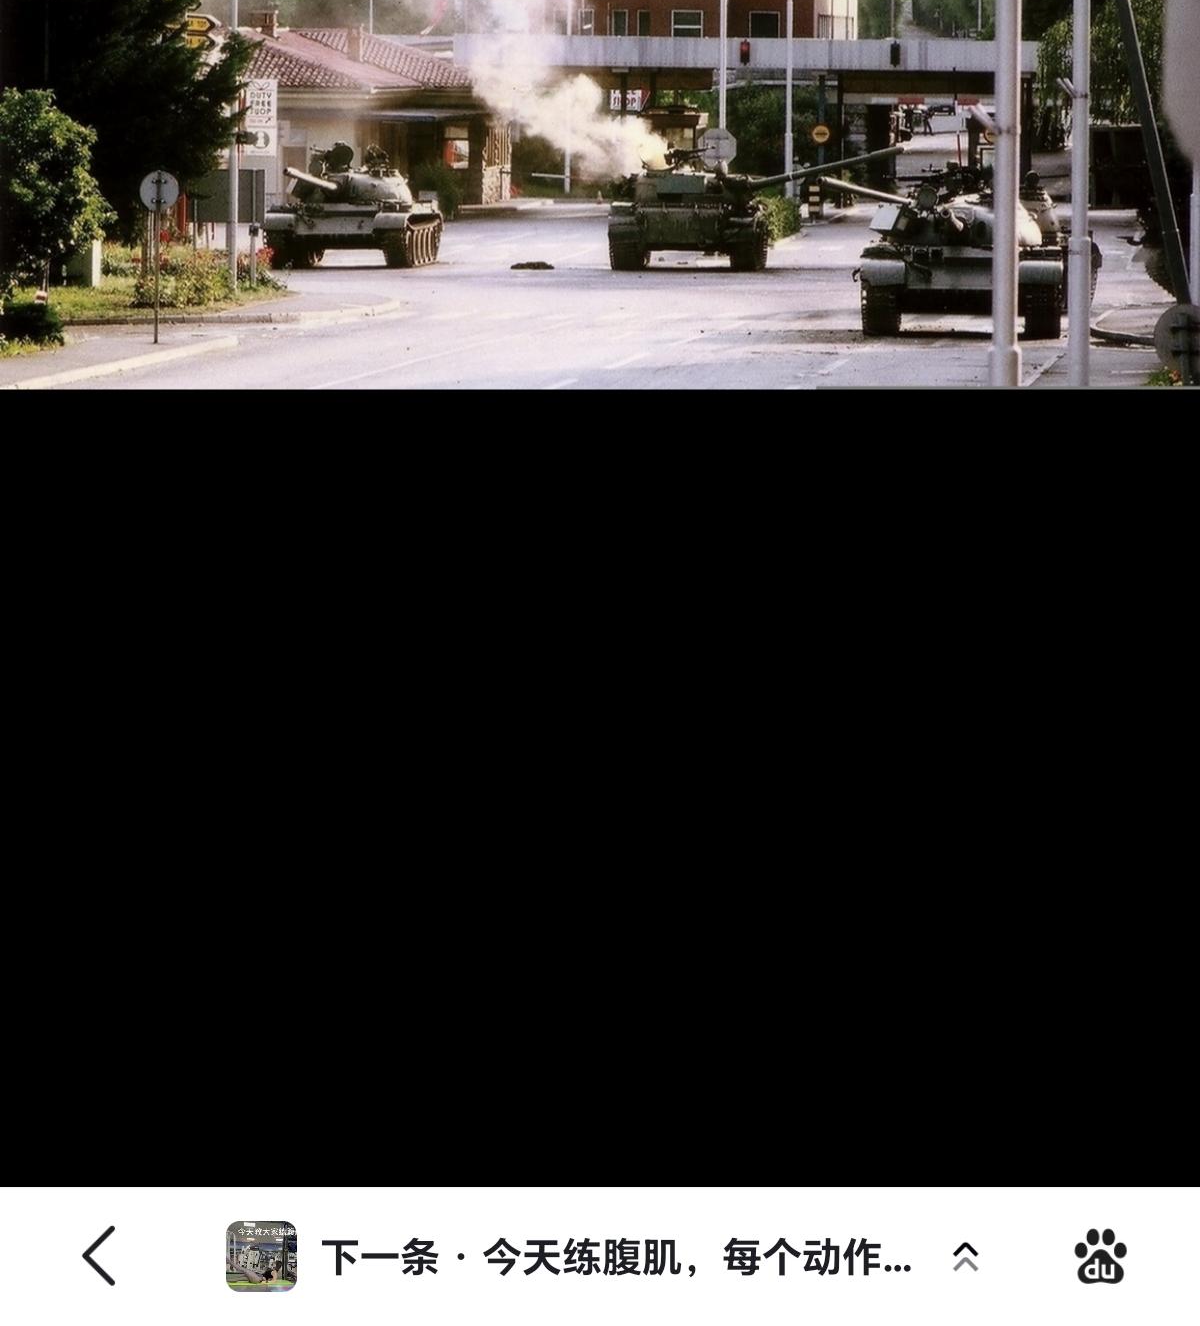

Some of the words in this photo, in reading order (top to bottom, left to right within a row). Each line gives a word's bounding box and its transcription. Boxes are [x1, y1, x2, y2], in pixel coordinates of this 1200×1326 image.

[249, 91, 272, 100] DUTY
[249, 100, 272, 108] FREE
[1084, 1258, 1115, 1279] du
